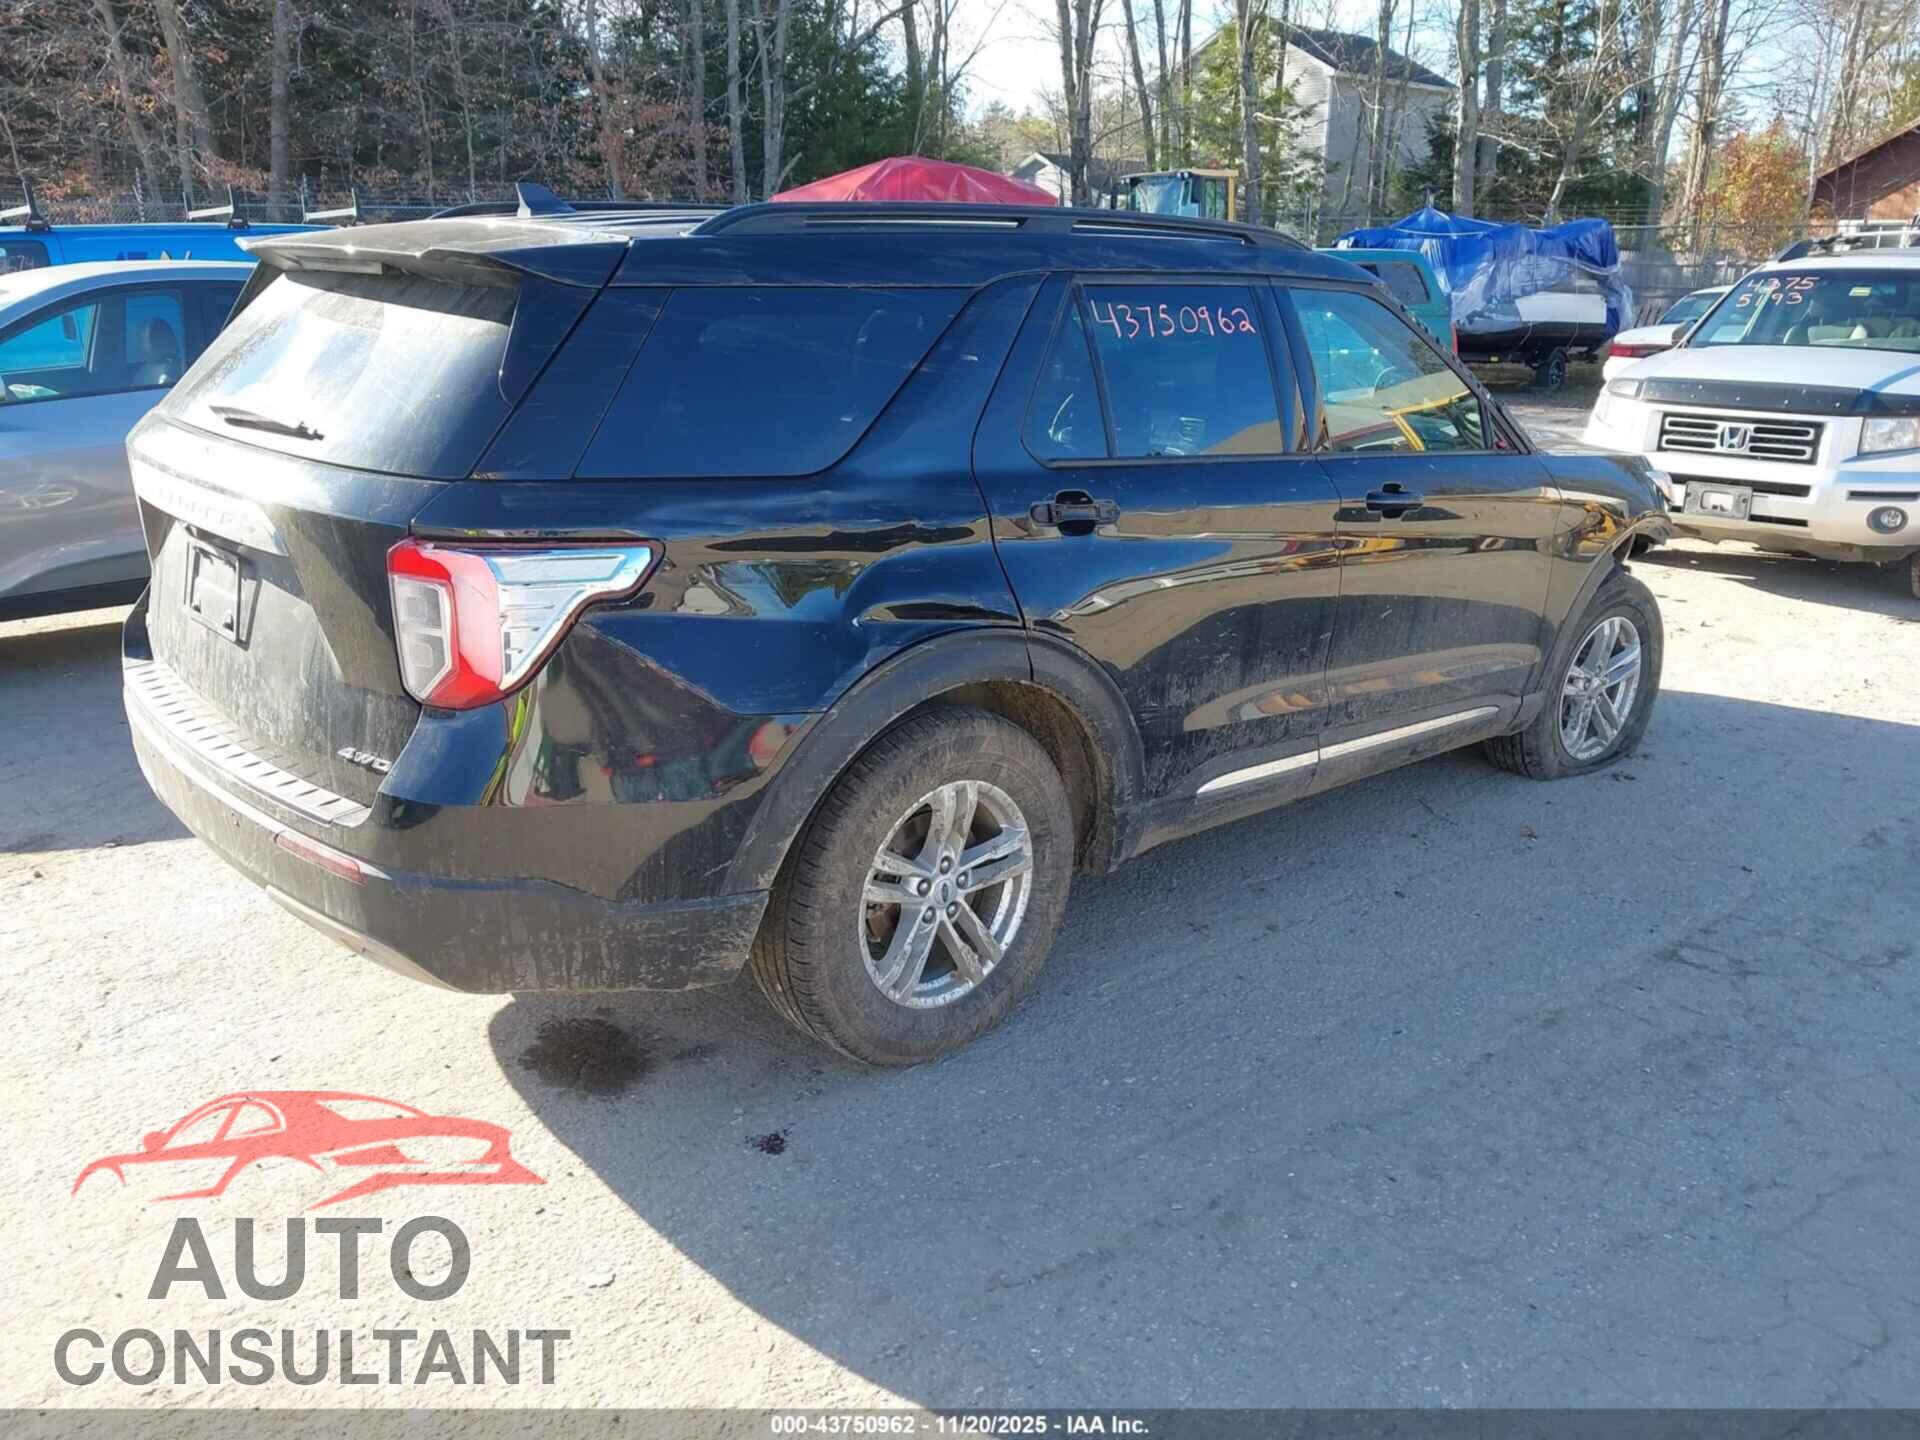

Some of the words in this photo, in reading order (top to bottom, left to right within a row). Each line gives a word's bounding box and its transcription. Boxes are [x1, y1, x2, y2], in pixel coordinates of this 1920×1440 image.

[1747, 276, 1820, 293] 4375
[1090, 299, 1256, 338] 43750962
[337, 747, 392, 772] 4WD
